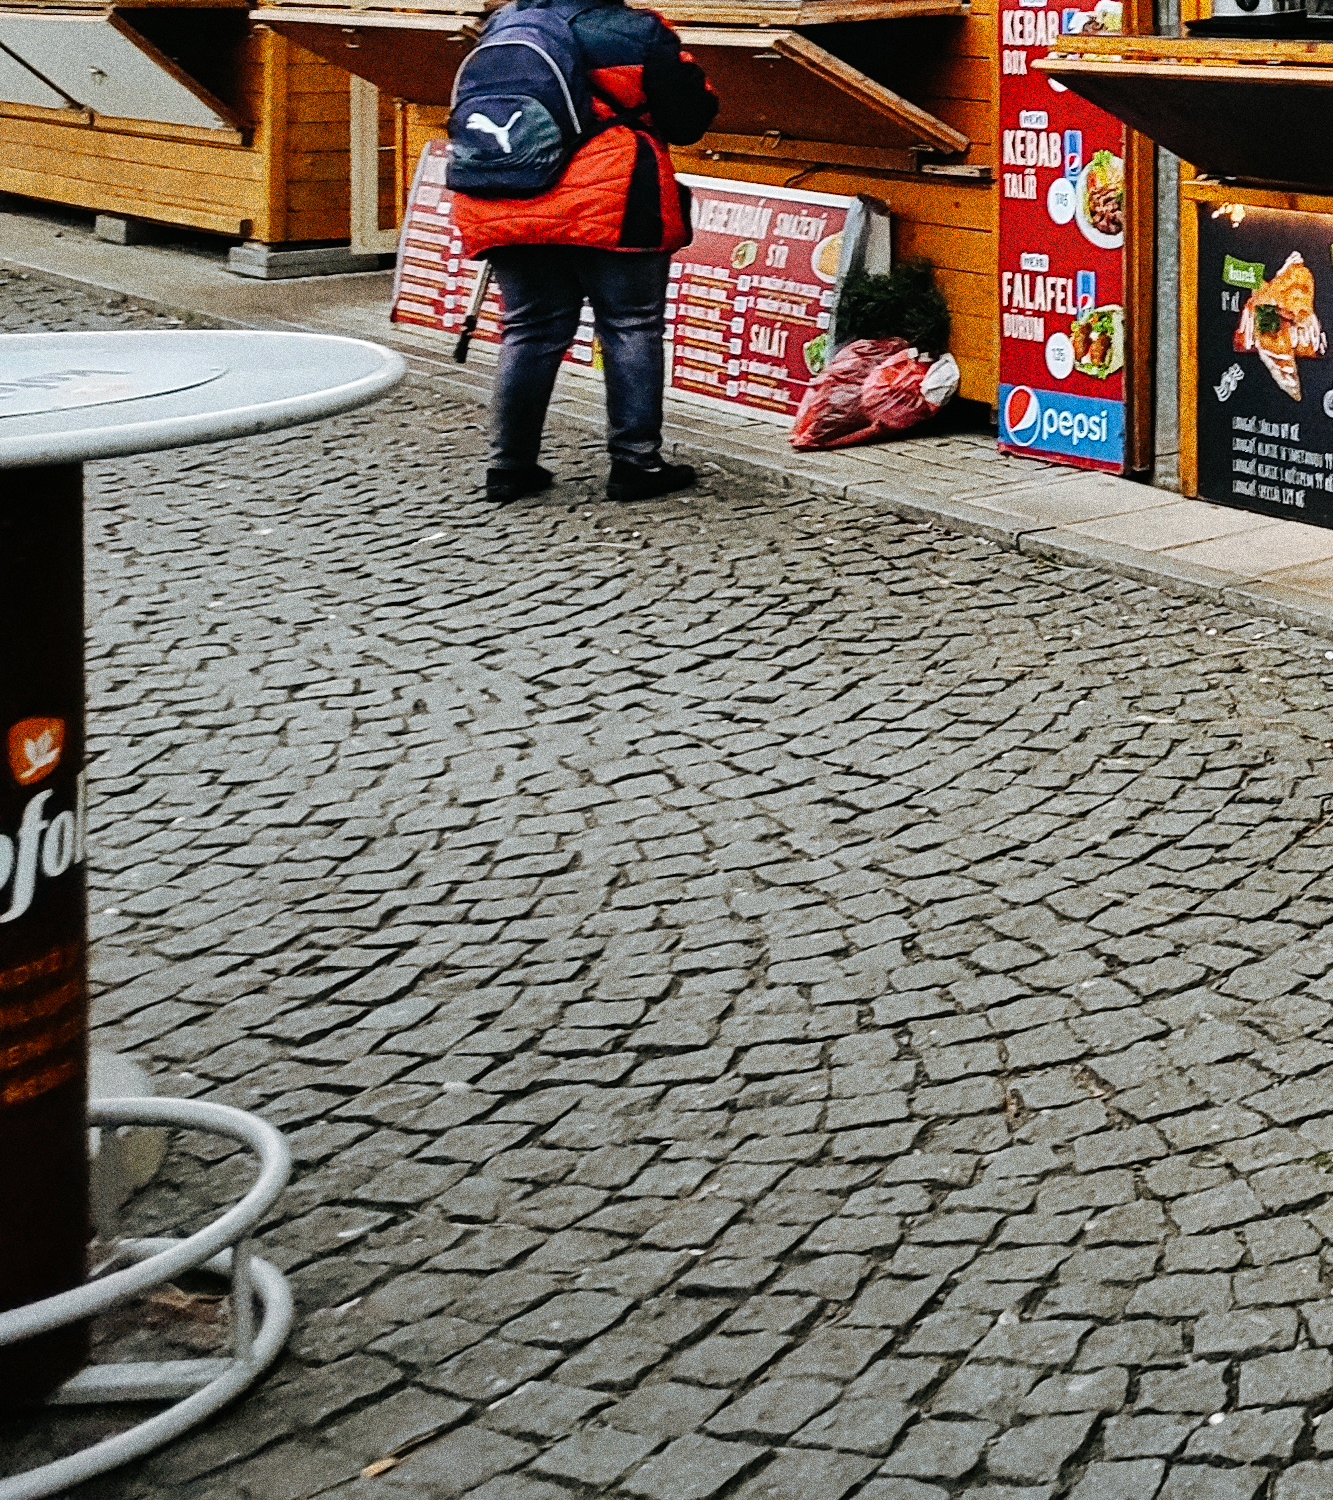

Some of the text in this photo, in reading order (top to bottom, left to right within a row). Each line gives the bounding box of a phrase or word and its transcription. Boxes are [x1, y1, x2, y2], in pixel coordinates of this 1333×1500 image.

[1002, 10, 1060, 47] KEBAB
[1002, 49, 1027, 75] BOX
[1002, 129, 1062, 168] KEBAB
[1002, 271, 1077, 317] FALAFEL
[1003, 309, 1045, 343] DÜRÜM
[1042, 408, 1109, 444] pepsi
